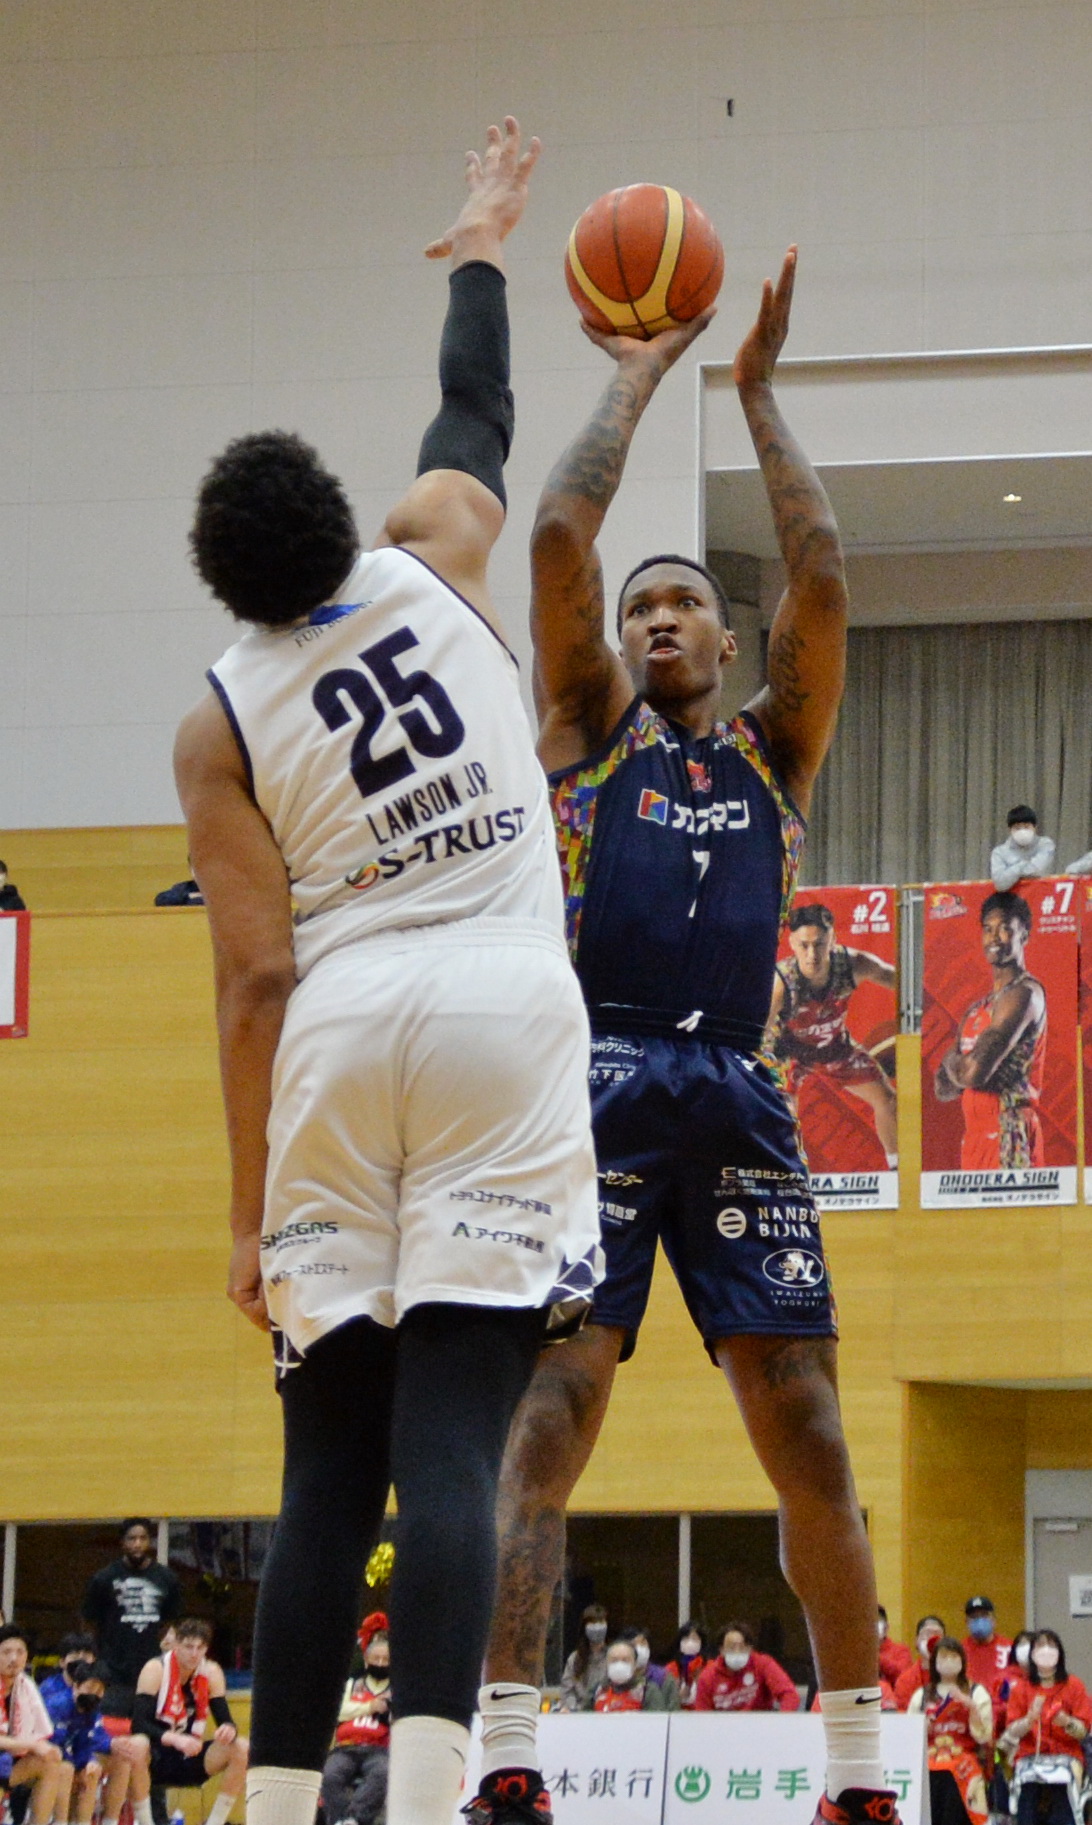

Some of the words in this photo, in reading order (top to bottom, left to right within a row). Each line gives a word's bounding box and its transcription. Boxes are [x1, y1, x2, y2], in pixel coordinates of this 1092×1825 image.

[312, 625, 465, 799] 25
[365, 773, 462, 846] LAWSON
[463, 761, 493, 798] JR.
[378, 806, 526, 881] S-TRUST
[852, 890, 888, 923] #2
[1041, 882, 1074, 915] #7
[840, 1175, 880, 1189] SIGN
[940, 1173, 1017, 1187] ONODERA
[1023, 1170, 1060, 1184] SIGN
[759, 1222, 812, 1239] BIJIN
[550, 1767, 655, 1798] 本銀行
[726, 1767, 913, 1801] 岩手行
